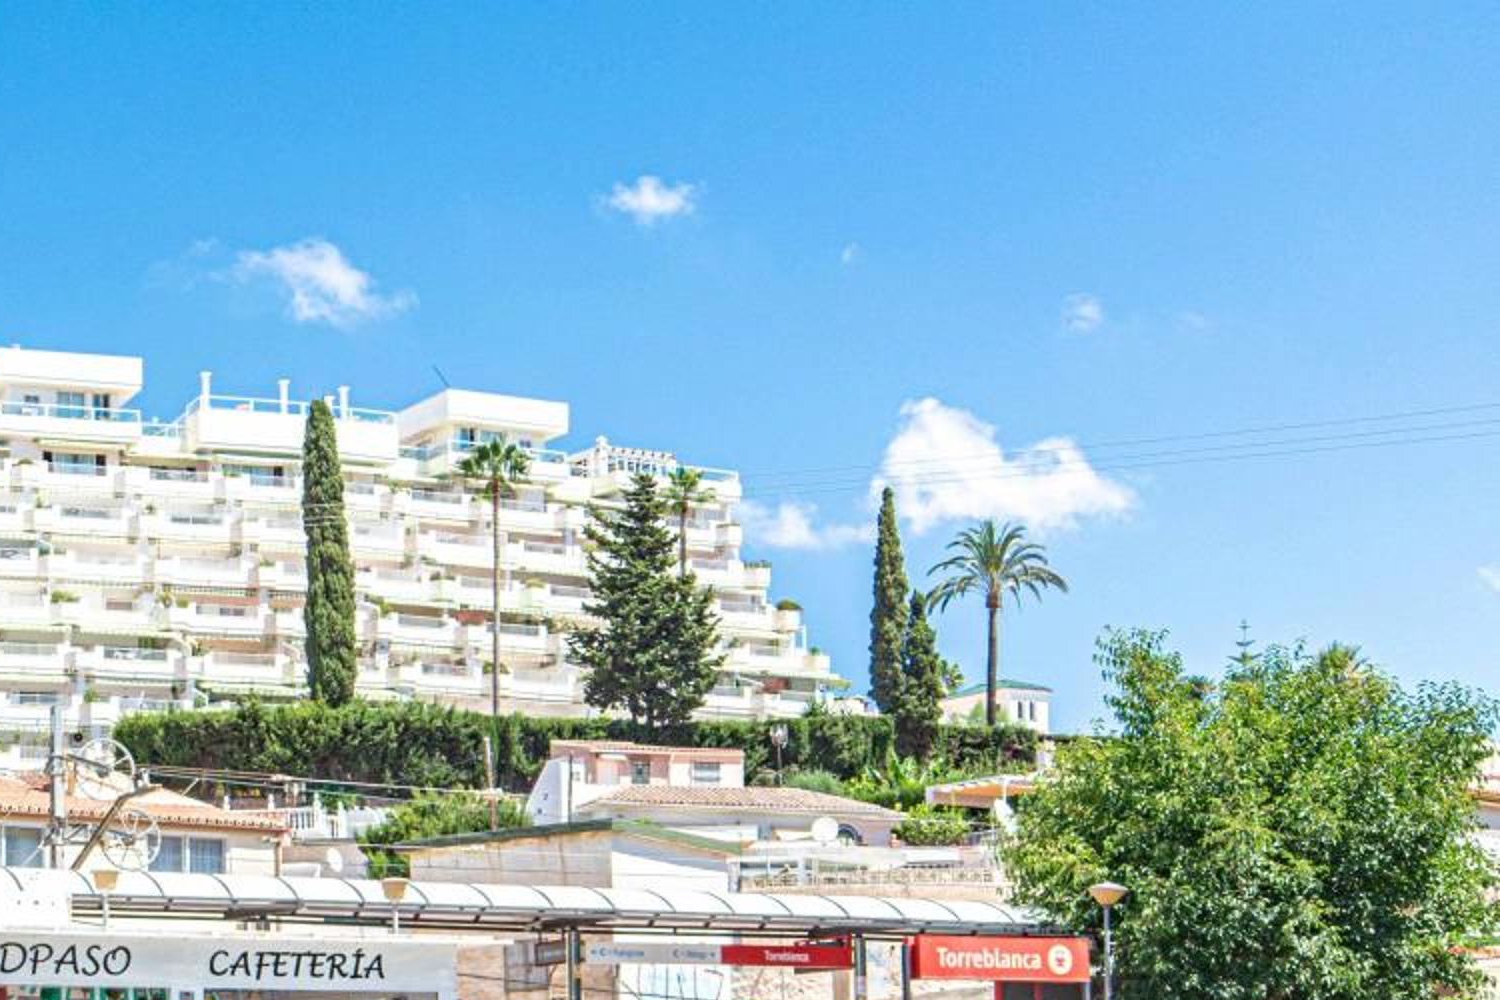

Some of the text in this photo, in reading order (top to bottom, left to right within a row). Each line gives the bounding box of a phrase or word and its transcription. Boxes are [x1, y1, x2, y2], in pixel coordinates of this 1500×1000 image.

[0, 942, 385, 980] DPASO CAFETERÍA
[935, 947, 1042, 970] Torreblanca
